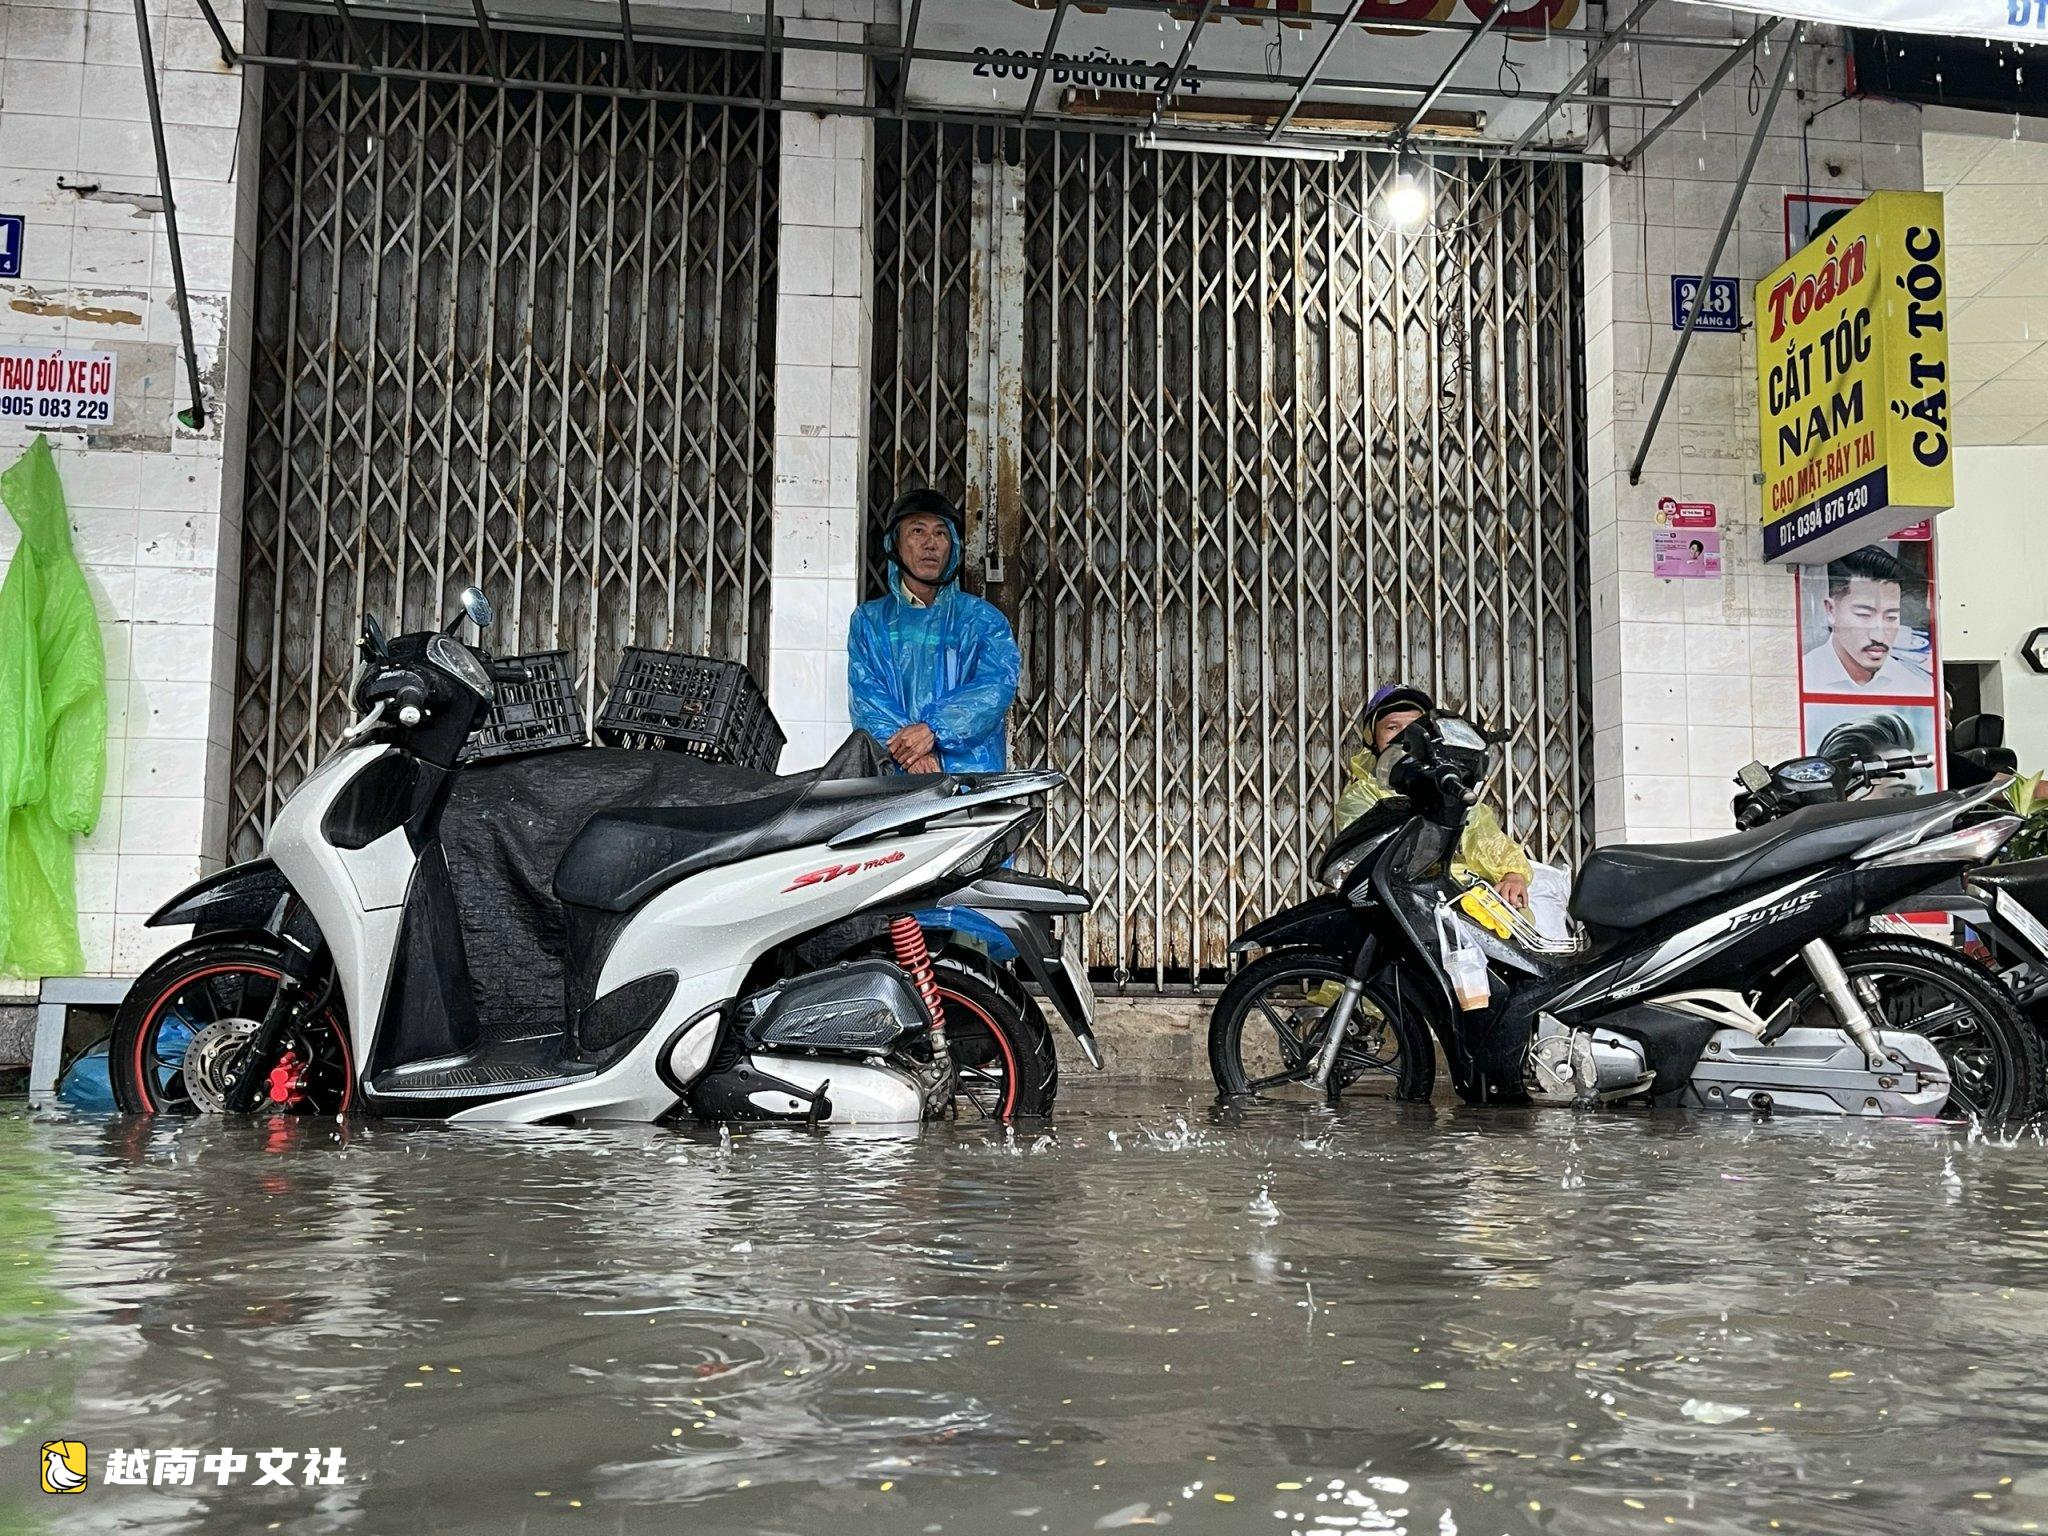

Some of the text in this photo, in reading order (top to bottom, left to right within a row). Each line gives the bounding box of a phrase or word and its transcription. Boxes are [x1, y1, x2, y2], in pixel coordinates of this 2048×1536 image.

[1695, 314, 1723, 326] HÁNG
[37, 349, 64, 392] ĐỔI
[66, 360, 87, 393] XE
[90, 356, 111, 395] CŨ
[1769, 308, 1871, 416] CẮT TÓC
[1890, 226, 1950, 468] CẮT TÓC
[39, 397, 71, 418] 083
[76, 399, 109, 420] 229
[1778, 380, 1864, 466] NAM
[1772, 475, 1794, 513] CẠO
[1854, 430, 1875, 468] TAI
[1797, 508, 1822, 539] 0394
[1824, 496, 1845, 525] 876
[1847, 484, 1868, 514] 230
[863, 850, 906, 871] mode
[1768, 901, 1814, 925] 125
